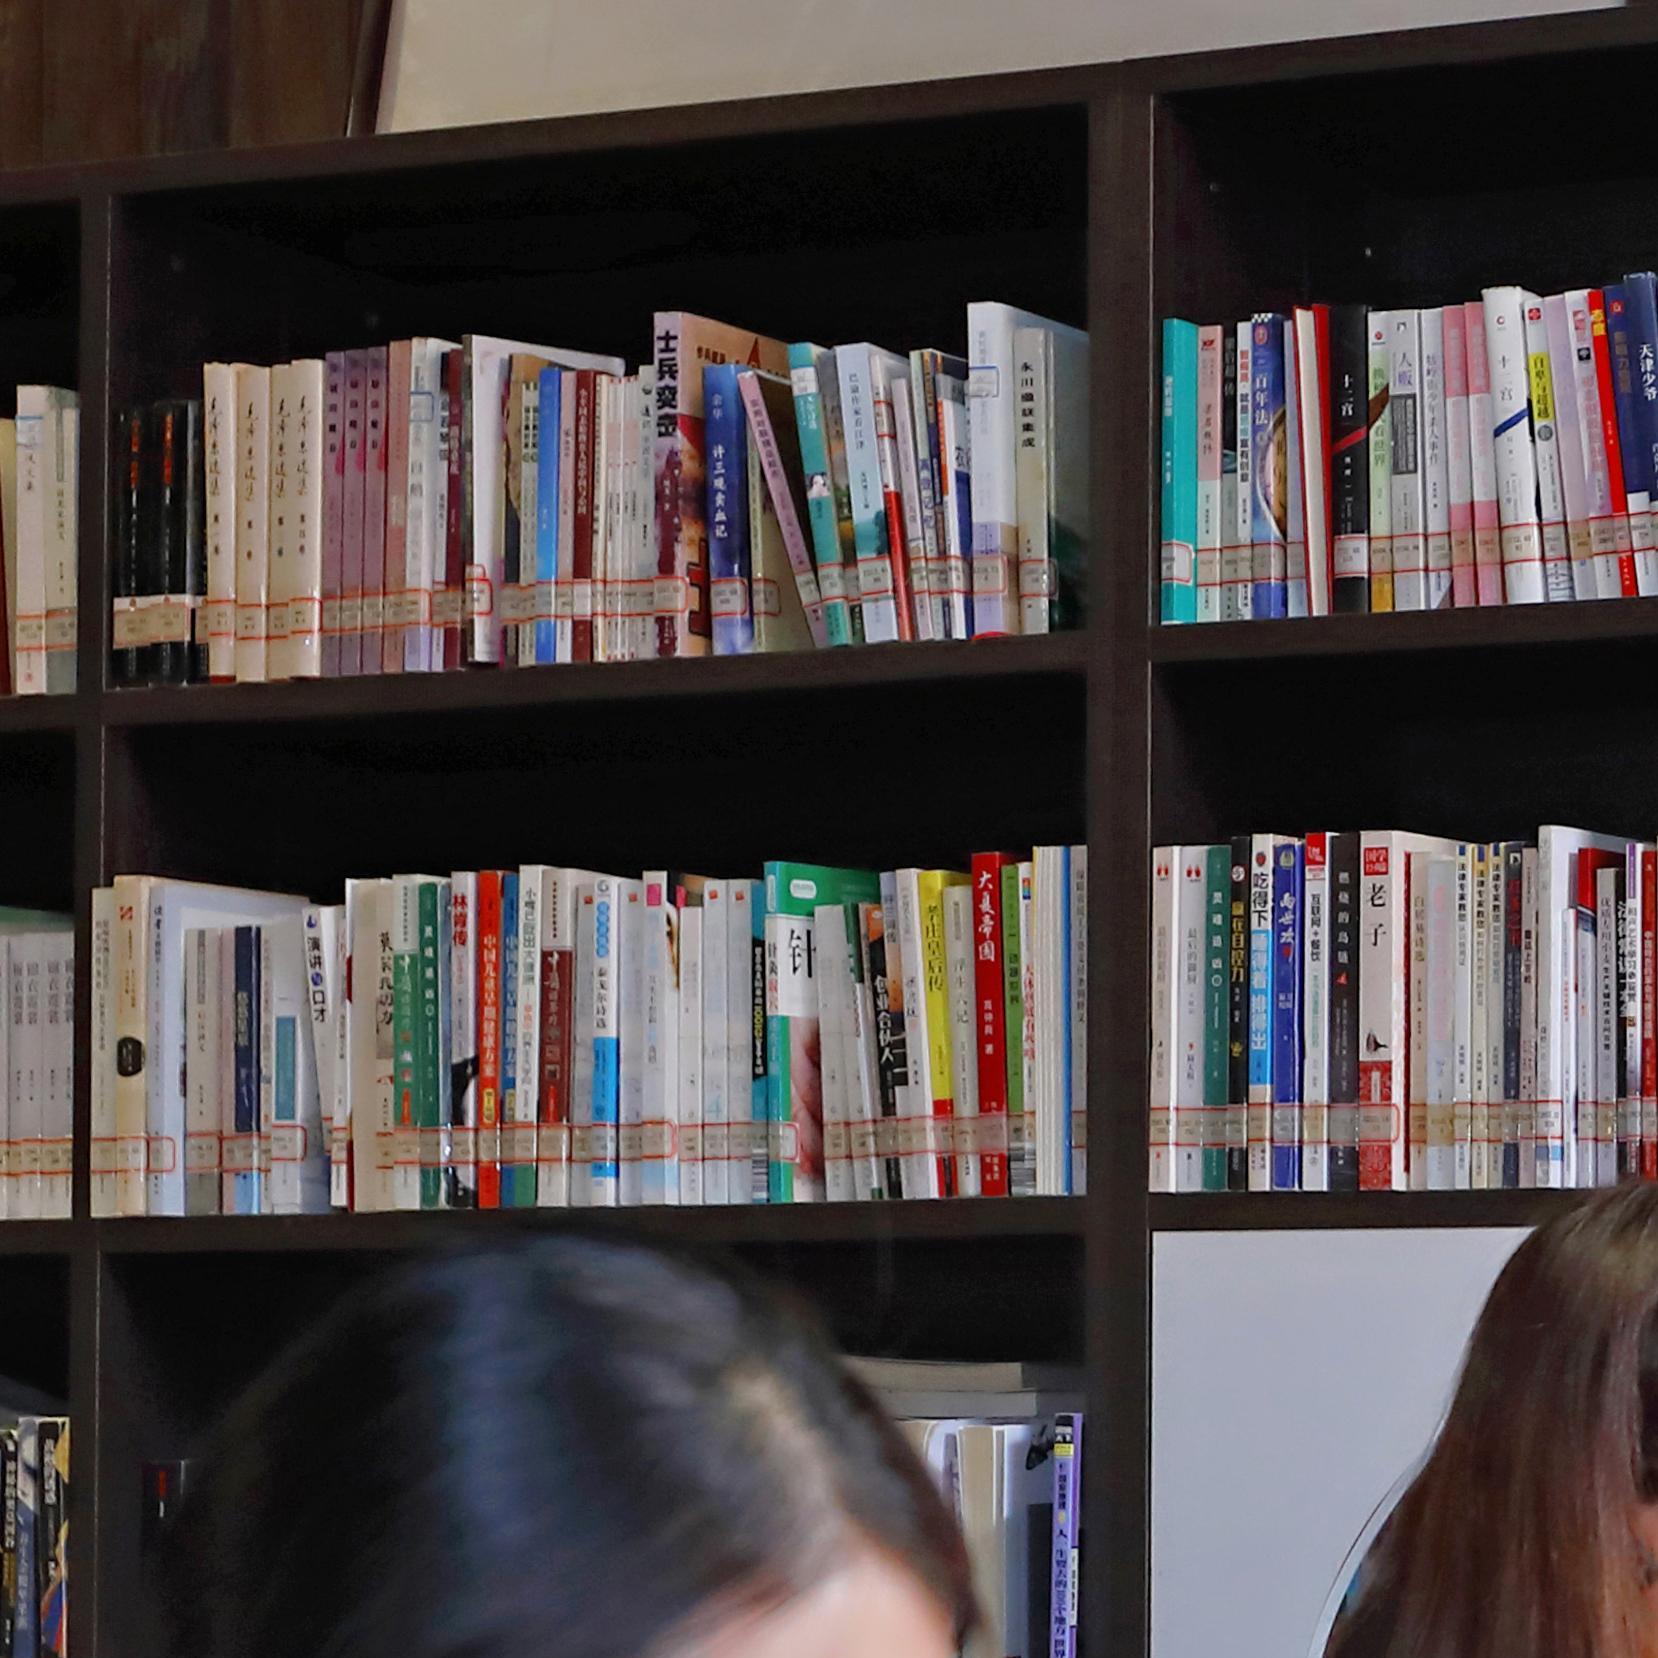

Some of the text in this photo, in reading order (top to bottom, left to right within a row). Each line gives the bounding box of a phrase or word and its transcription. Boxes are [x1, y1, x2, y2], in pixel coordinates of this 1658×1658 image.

[1639, 343, 1658, 401] 天津少爷
[711, 444, 729, 538] 许三观卖血记
[1252, 872, 1270, 929] 吃得下
[1365, 881, 1388, 948] 老子
